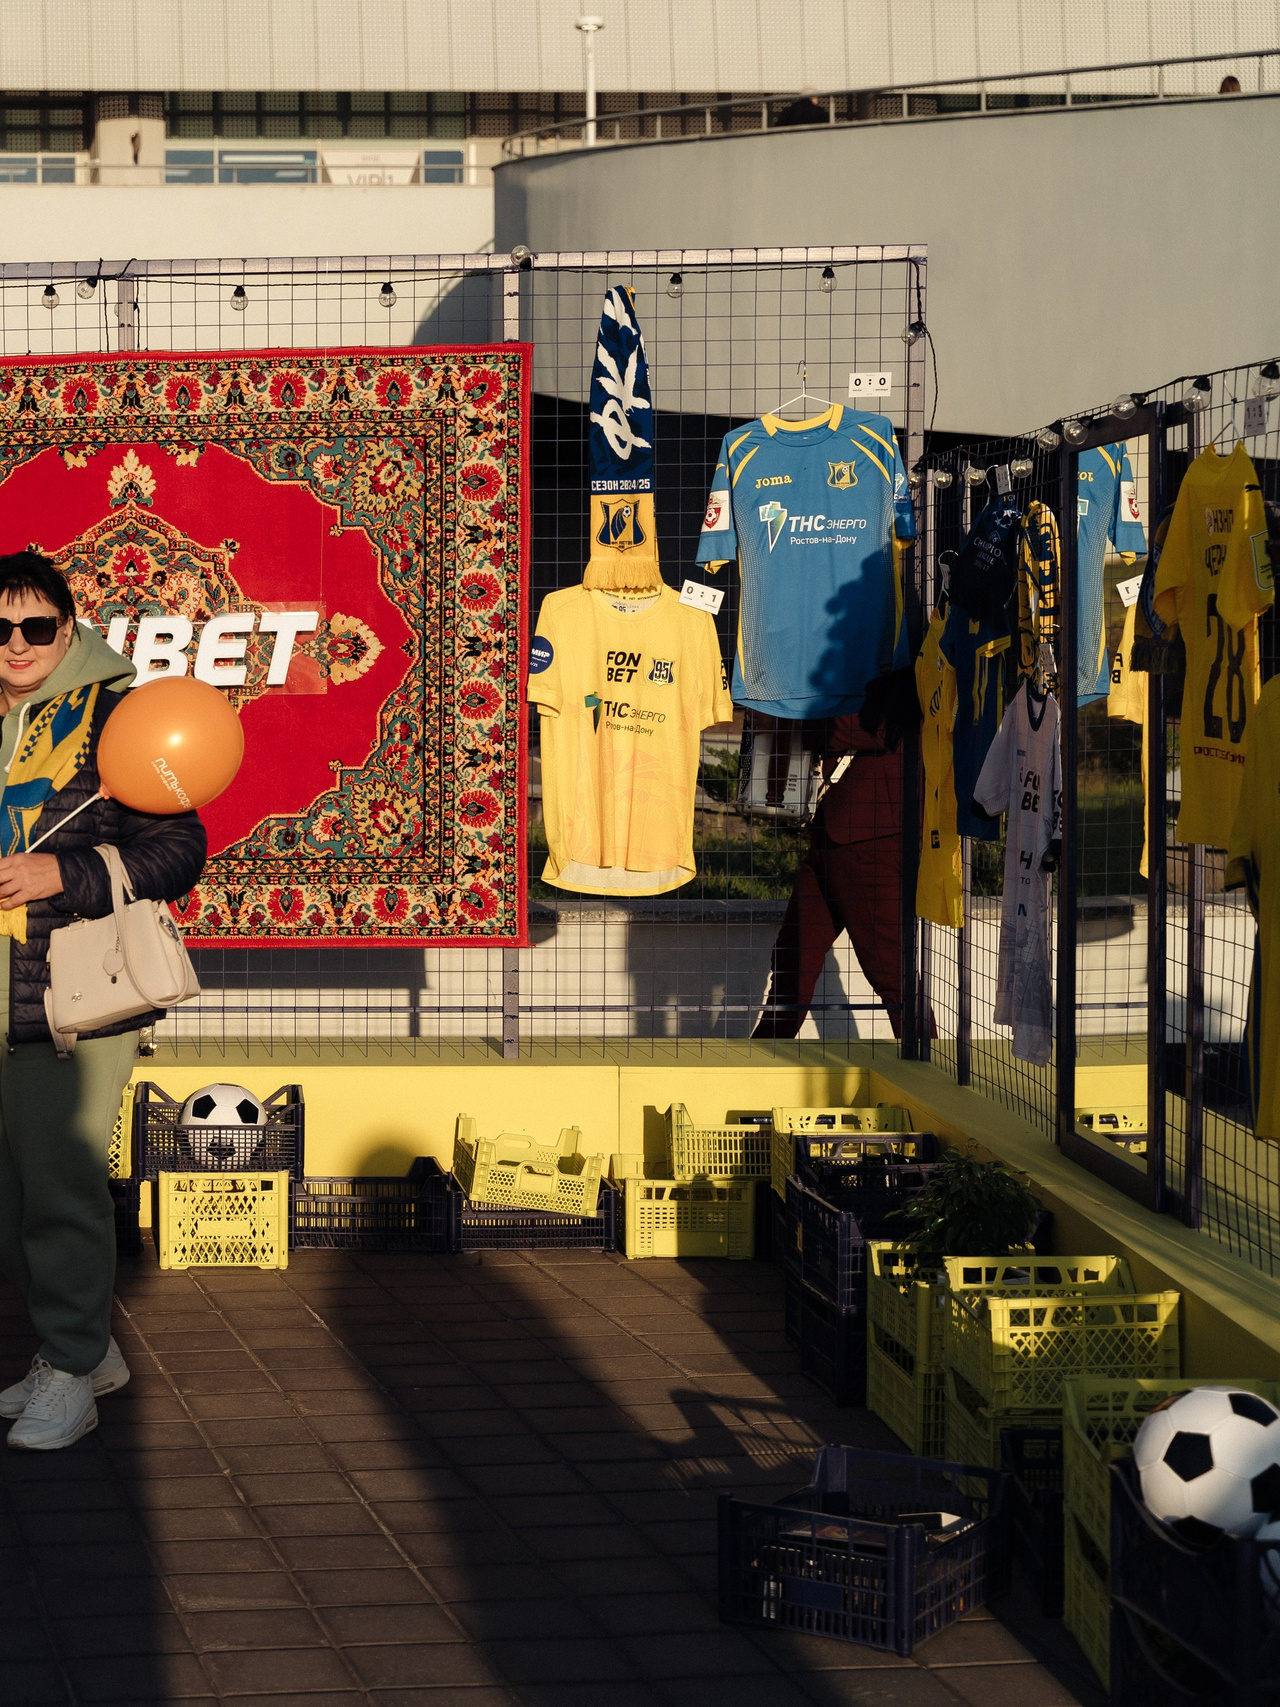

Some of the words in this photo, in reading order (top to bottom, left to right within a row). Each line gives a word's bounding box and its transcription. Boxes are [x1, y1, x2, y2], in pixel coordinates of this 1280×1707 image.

[591, 480, 619, 491] СЕЗОН
[788, 514, 827, 533] ТНС
[826, 518, 867, 530] ЭНЕРГО
[790, 534, 857, 545] Ростов-на-Дону
[606, 651, 642, 668] FON
[607, 667, 638, 683] BET
[629, 708, 667, 724] ЭНЕРГО
